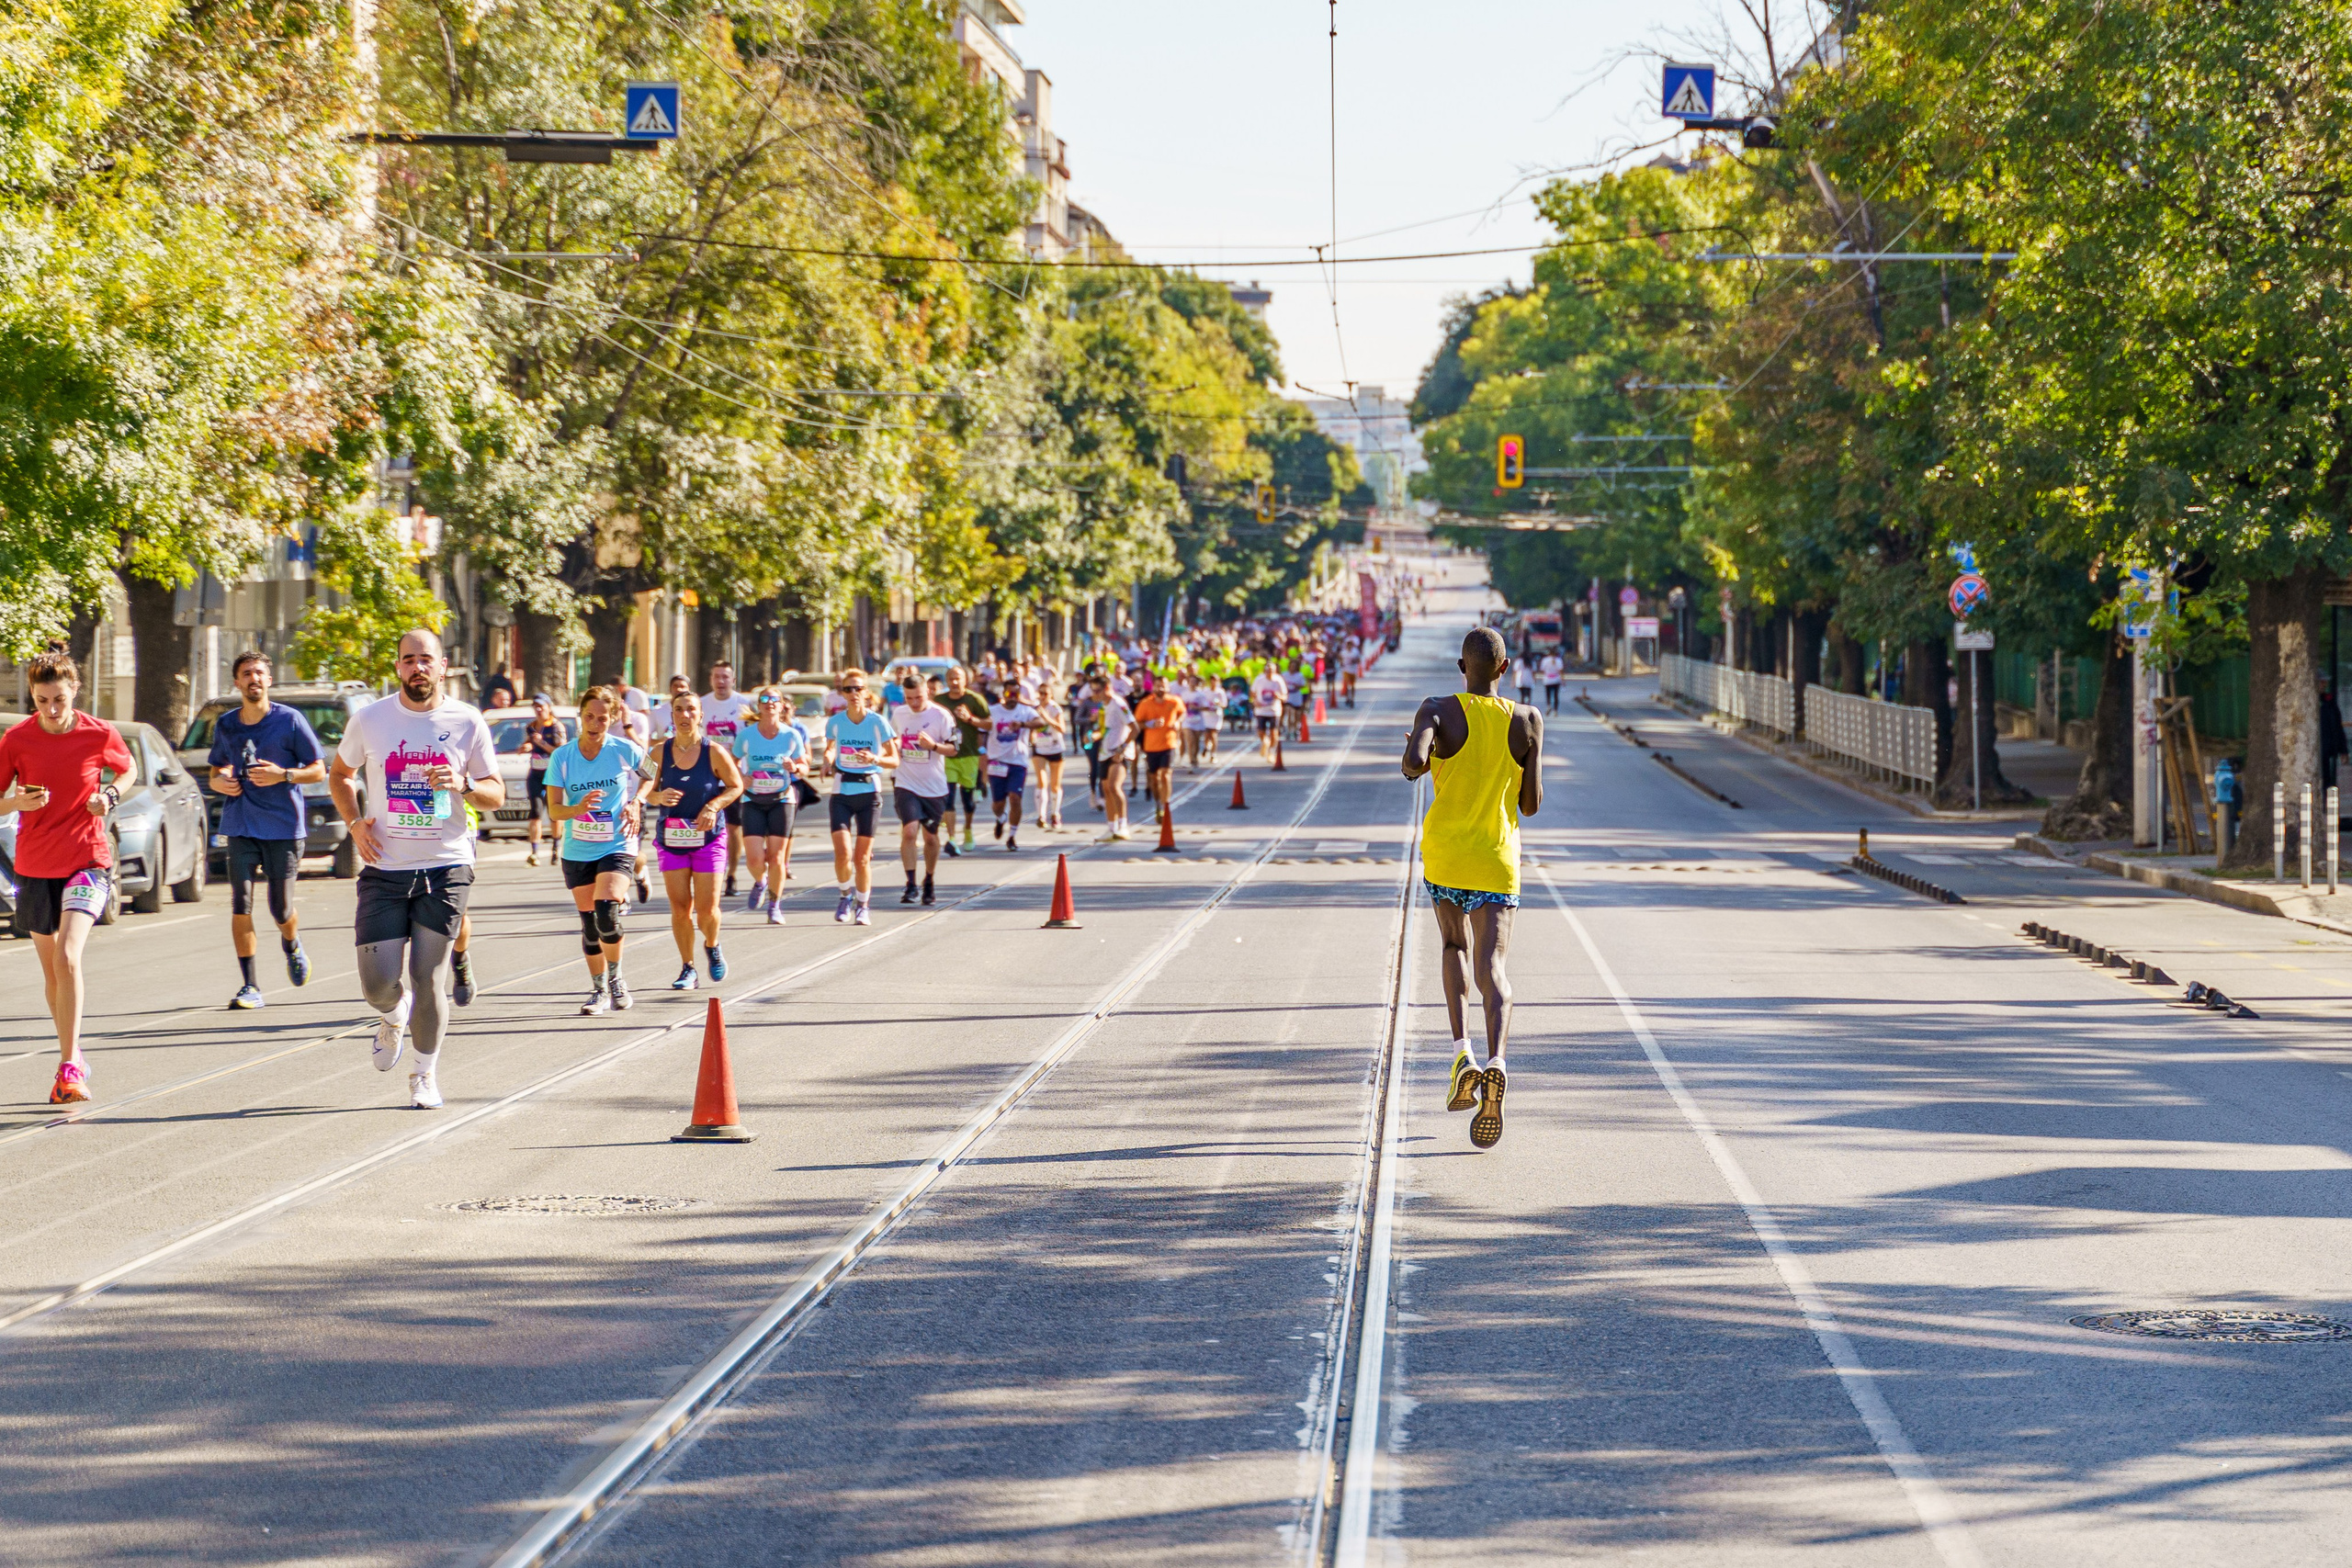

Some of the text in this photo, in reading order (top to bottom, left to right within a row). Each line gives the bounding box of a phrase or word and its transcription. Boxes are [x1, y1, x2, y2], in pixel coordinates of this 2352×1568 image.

[840, 739, 874, 747] GARMIN
[571, 777, 618, 792] GARMIN
[398, 814, 433, 827] 3582
[578, 822, 606, 832] 4642
[672, 829, 698, 838] 4303
